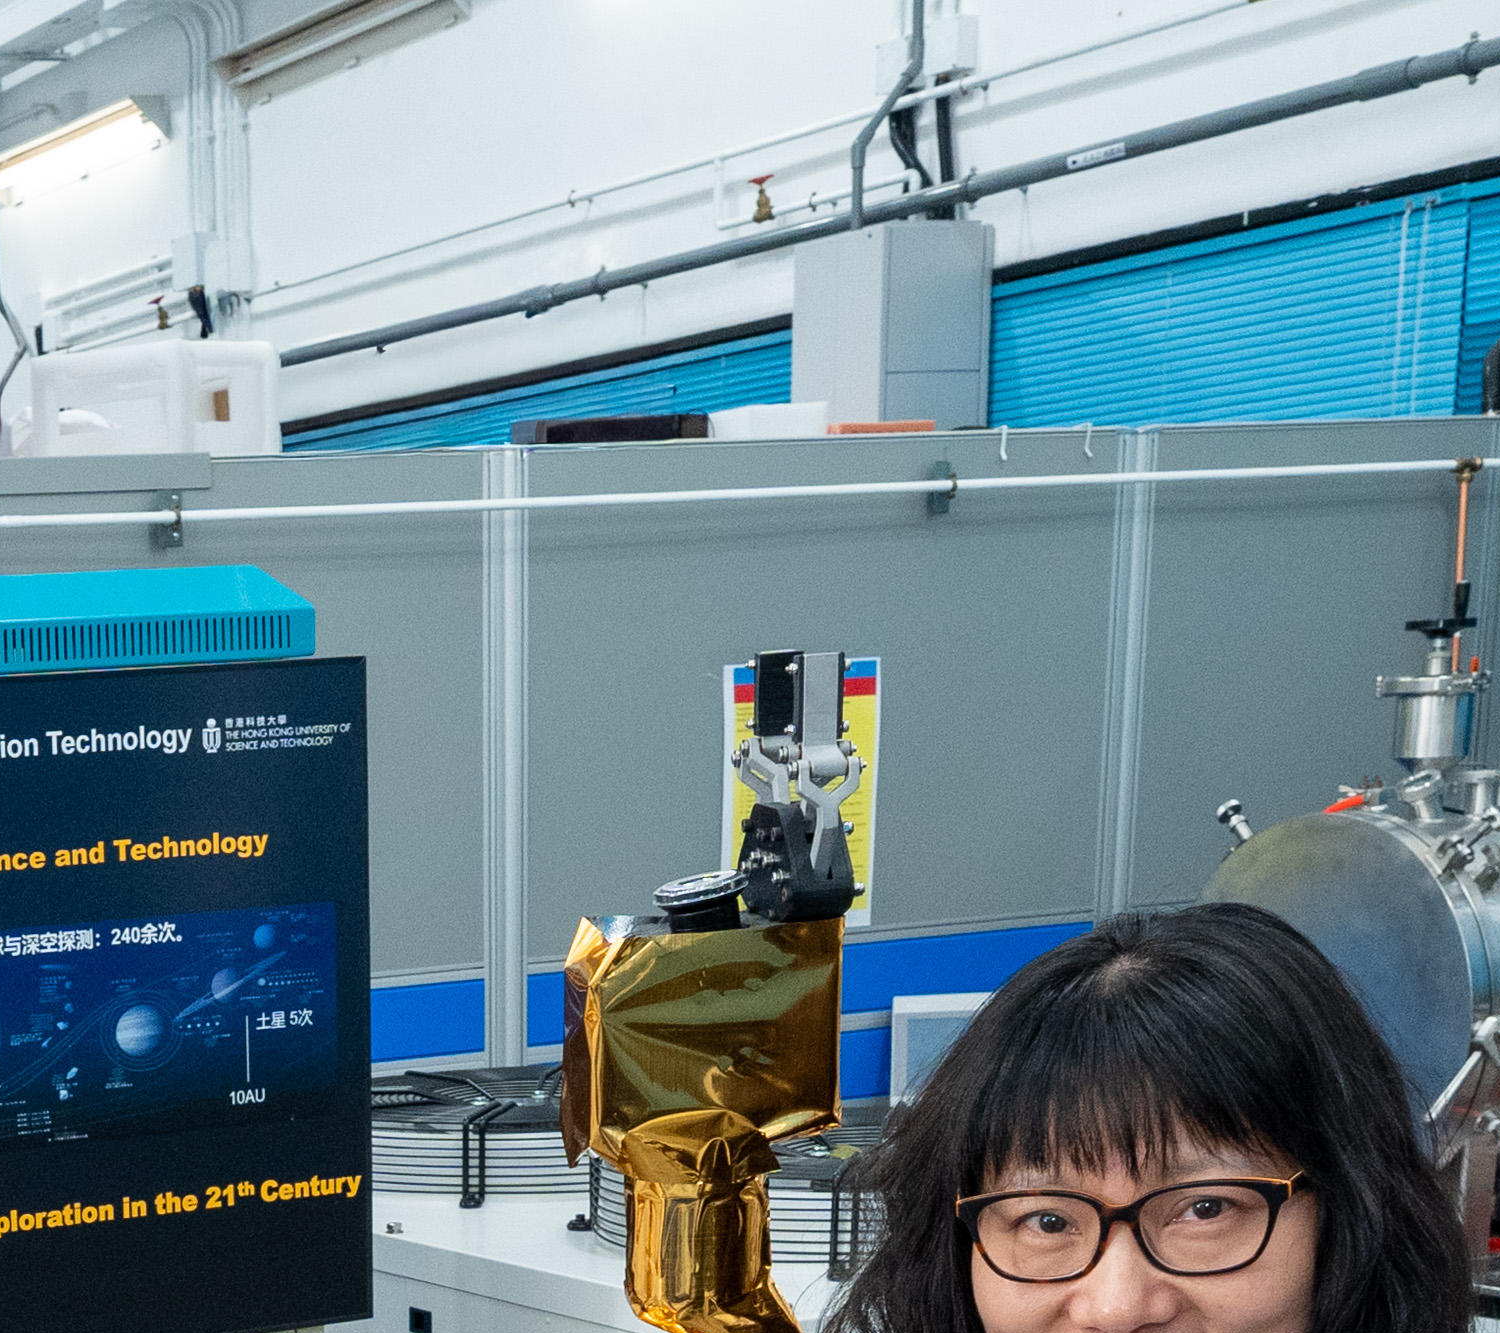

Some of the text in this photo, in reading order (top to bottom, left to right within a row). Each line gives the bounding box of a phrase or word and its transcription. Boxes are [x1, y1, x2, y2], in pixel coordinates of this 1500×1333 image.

[46, 725, 192, 755] Technology
[225, 722, 351, 739] THE HONG KONG UNIVERSITY OF
[225, 736, 333, 751] SCIENCE AND TECHNOLOGY
[54, 842, 104, 866] and
[113, 831, 269, 861] Technology
[256, 1009, 313, 1030] 土星 5次
[230, 1088, 266, 1105] 10AU
[122, 1196, 146, 1220] in
[154, 1191, 198, 1214] the
[205, 1181, 256, 1209] 21th
[260, 1174, 362, 1202] Century
